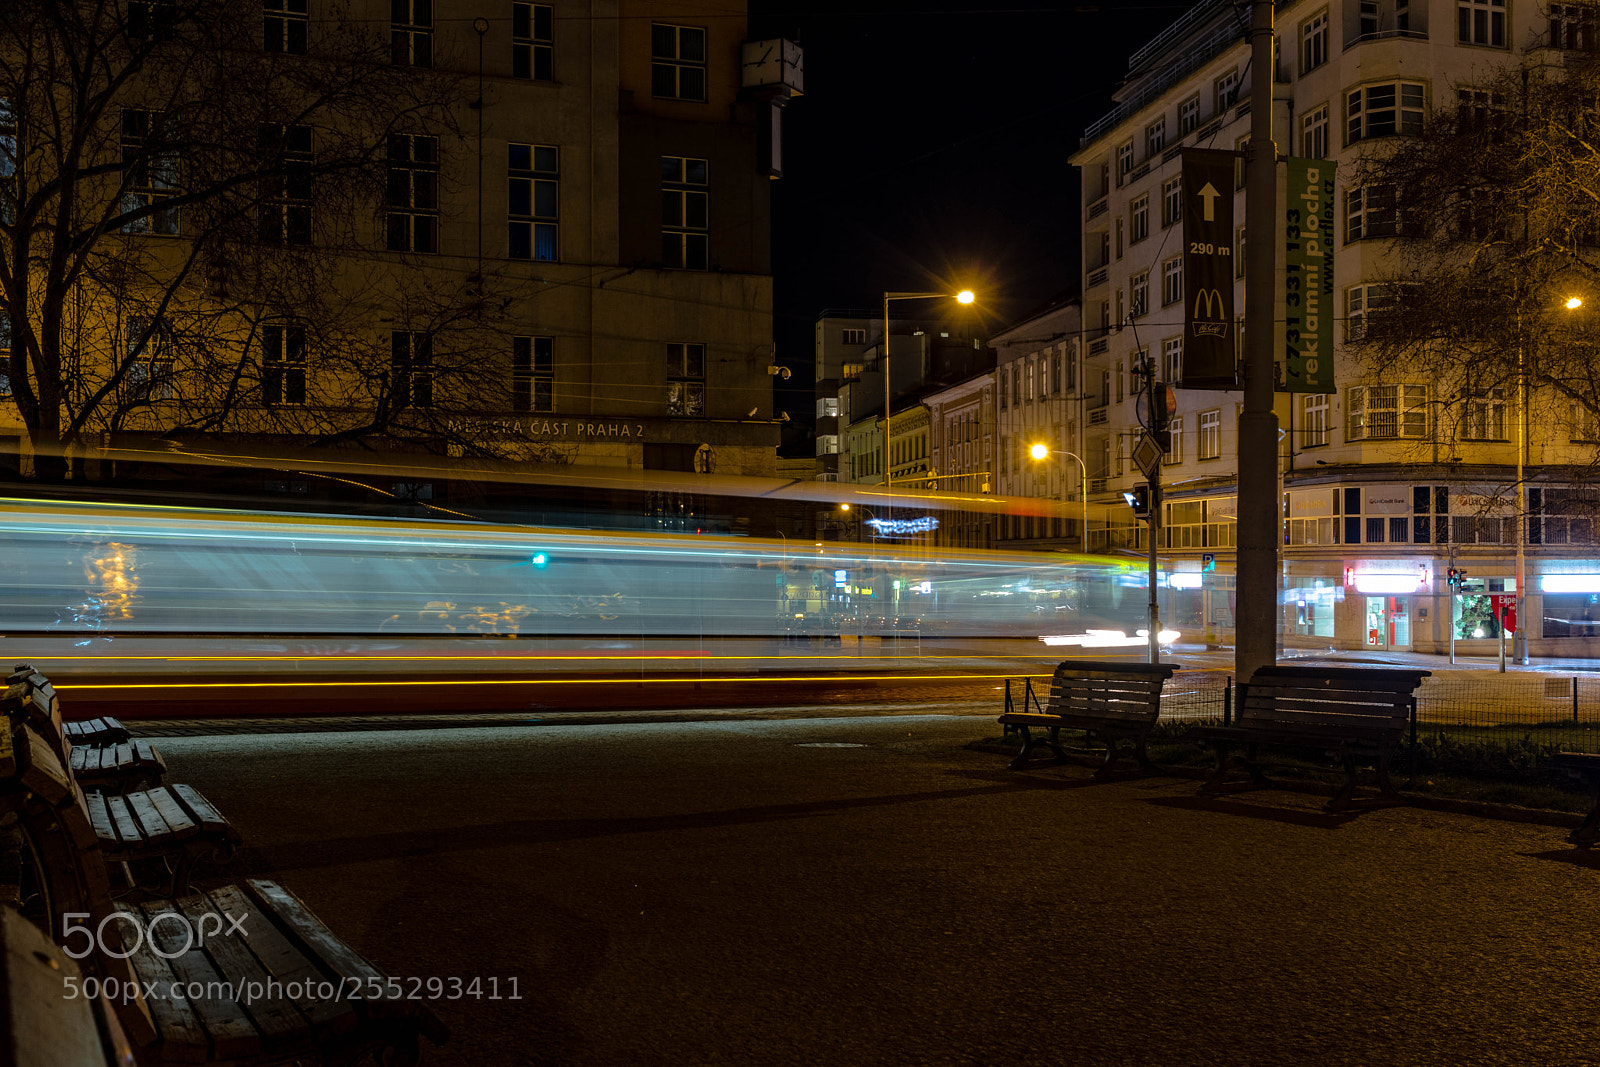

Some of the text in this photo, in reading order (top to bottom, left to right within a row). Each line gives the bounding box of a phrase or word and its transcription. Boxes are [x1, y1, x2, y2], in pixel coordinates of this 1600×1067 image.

[1190, 242, 1231, 256] 290 m
[1319, 179, 1335, 296] www.erflex.cz
[1286, 208, 1301, 360] 731 331 133
[1300, 167, 1325, 386] reklamní plocha
[530, 420, 569, 435] ČÁST
[577, 423, 631, 437] PRAHA
[636, 425, 644, 437] 2
[1499, 595, 1516, 605] Expe
